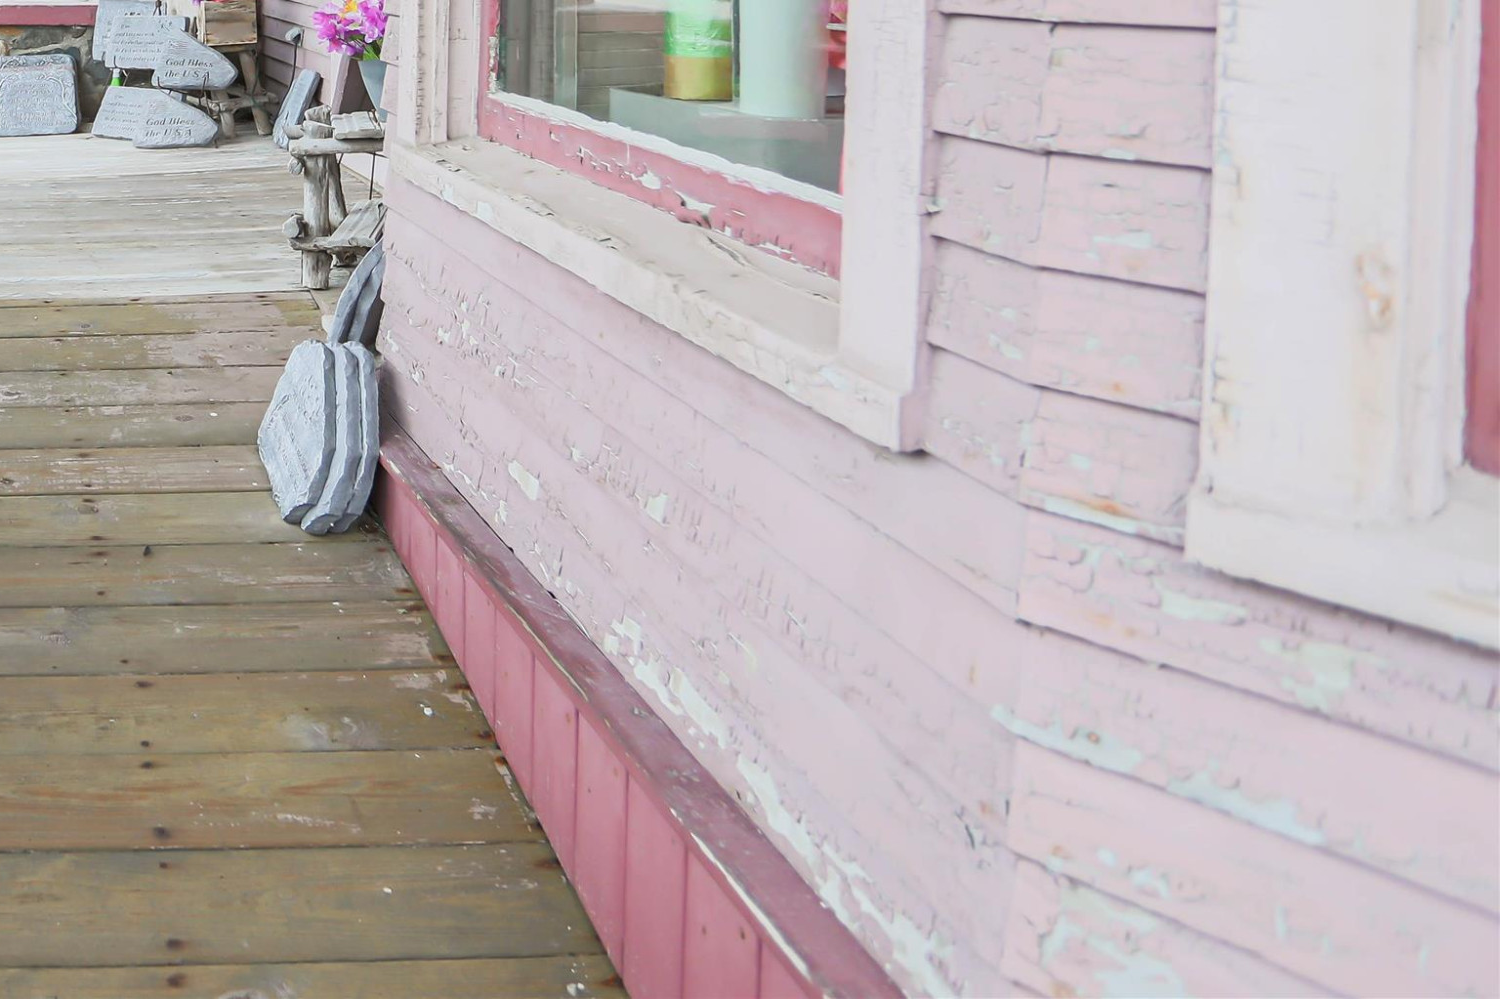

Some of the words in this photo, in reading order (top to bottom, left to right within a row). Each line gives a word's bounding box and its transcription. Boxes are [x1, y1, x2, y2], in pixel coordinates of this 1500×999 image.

[165, 58, 185, 67] God
[187, 59, 214, 68] Bless
[164, 70, 180, 78] the
[145, 117, 166, 126] God
[168, 117, 195, 126] Bless
[145, 128, 160, 137] the
